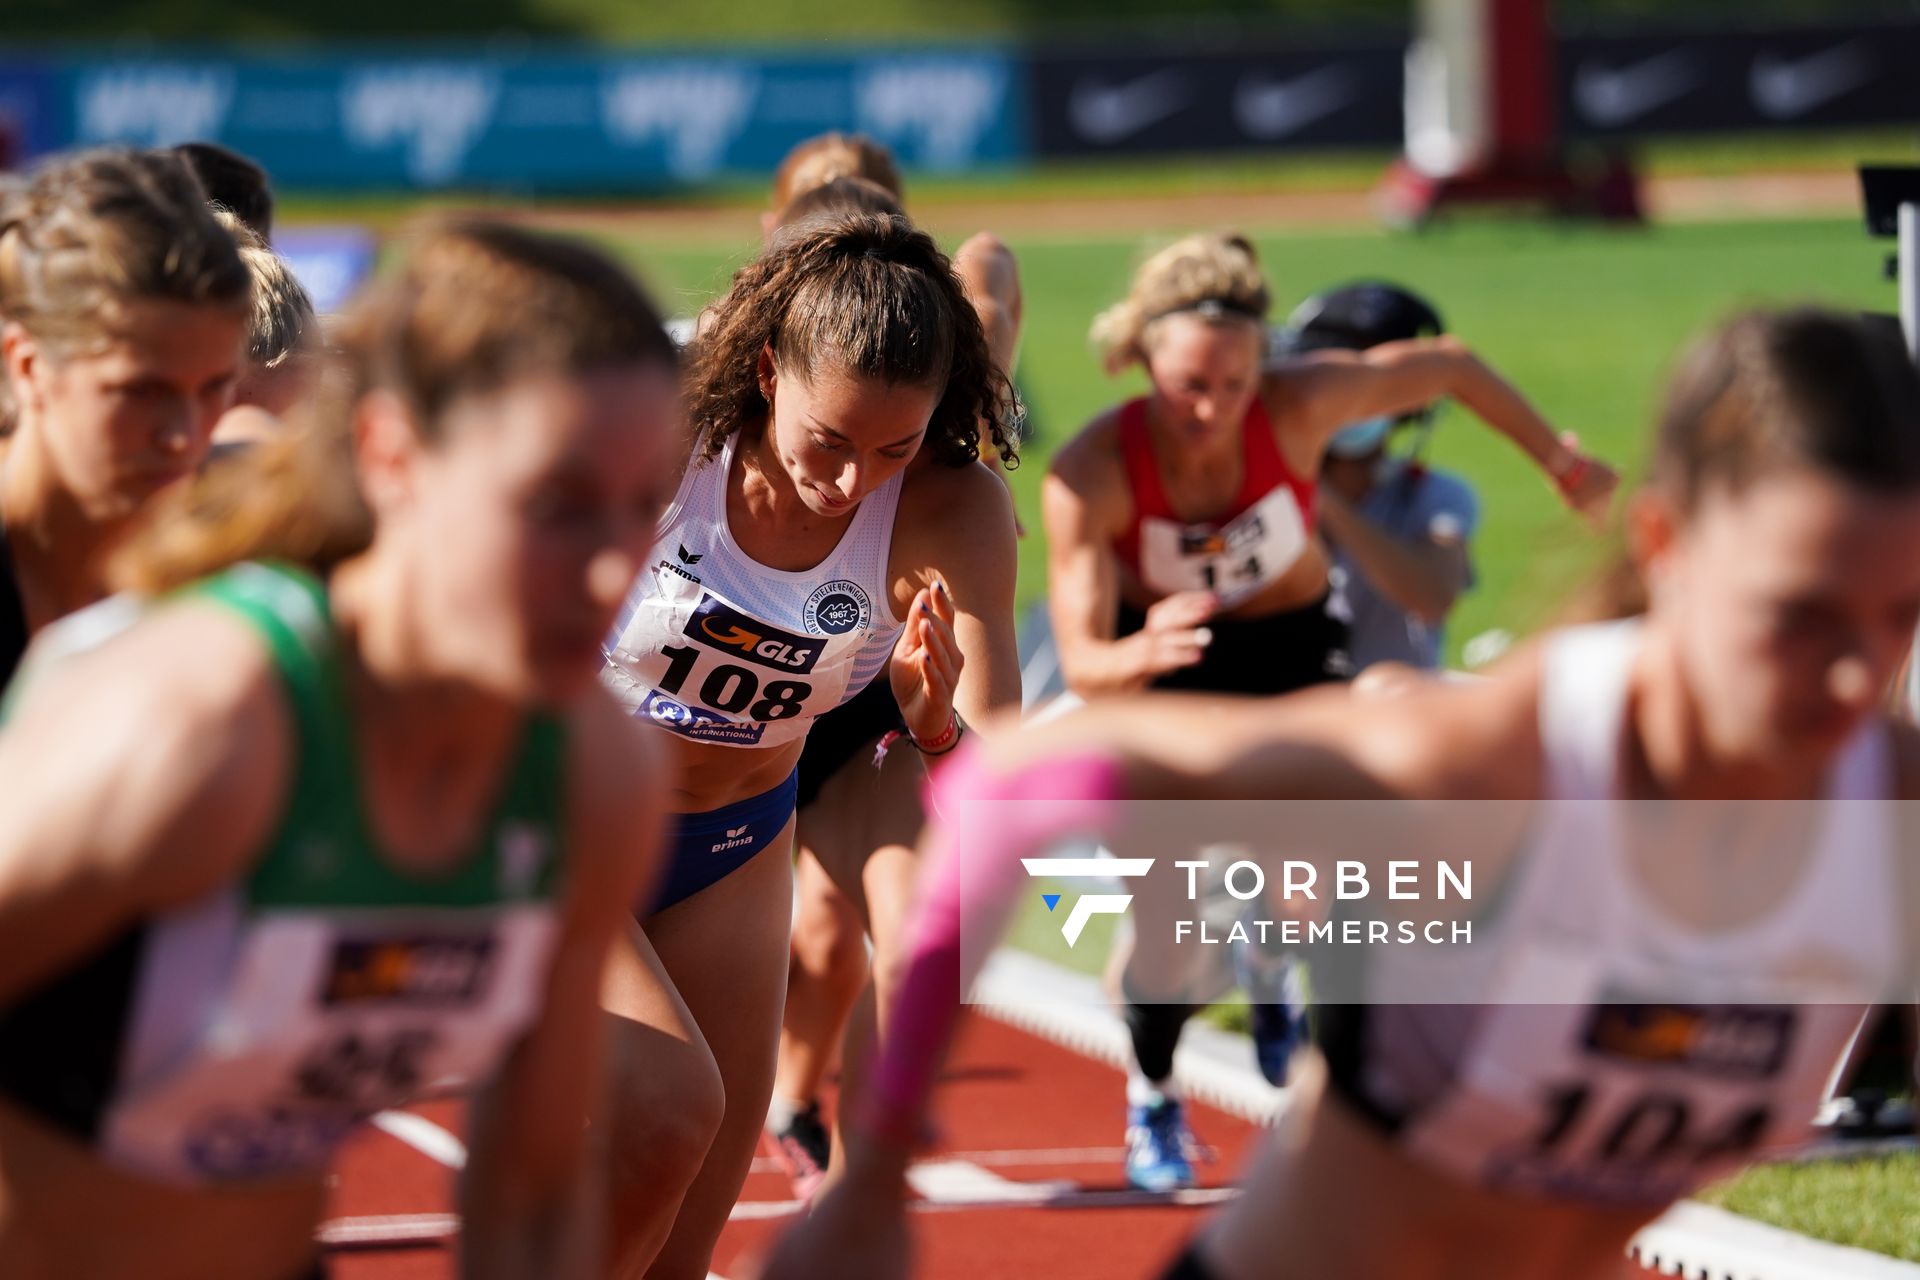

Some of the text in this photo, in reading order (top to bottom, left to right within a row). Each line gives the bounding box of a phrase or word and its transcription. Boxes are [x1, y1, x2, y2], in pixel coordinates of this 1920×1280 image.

[811, 582, 868, 609] SPIELVEREINIGUNG
[828, 610, 848, 619] 1967
[756, 640, 811, 667] GLS
[658, 644, 812, 722] 108
[689, 729, 757, 740] INTERNATIONAL
[711, 835, 753, 853] erima
